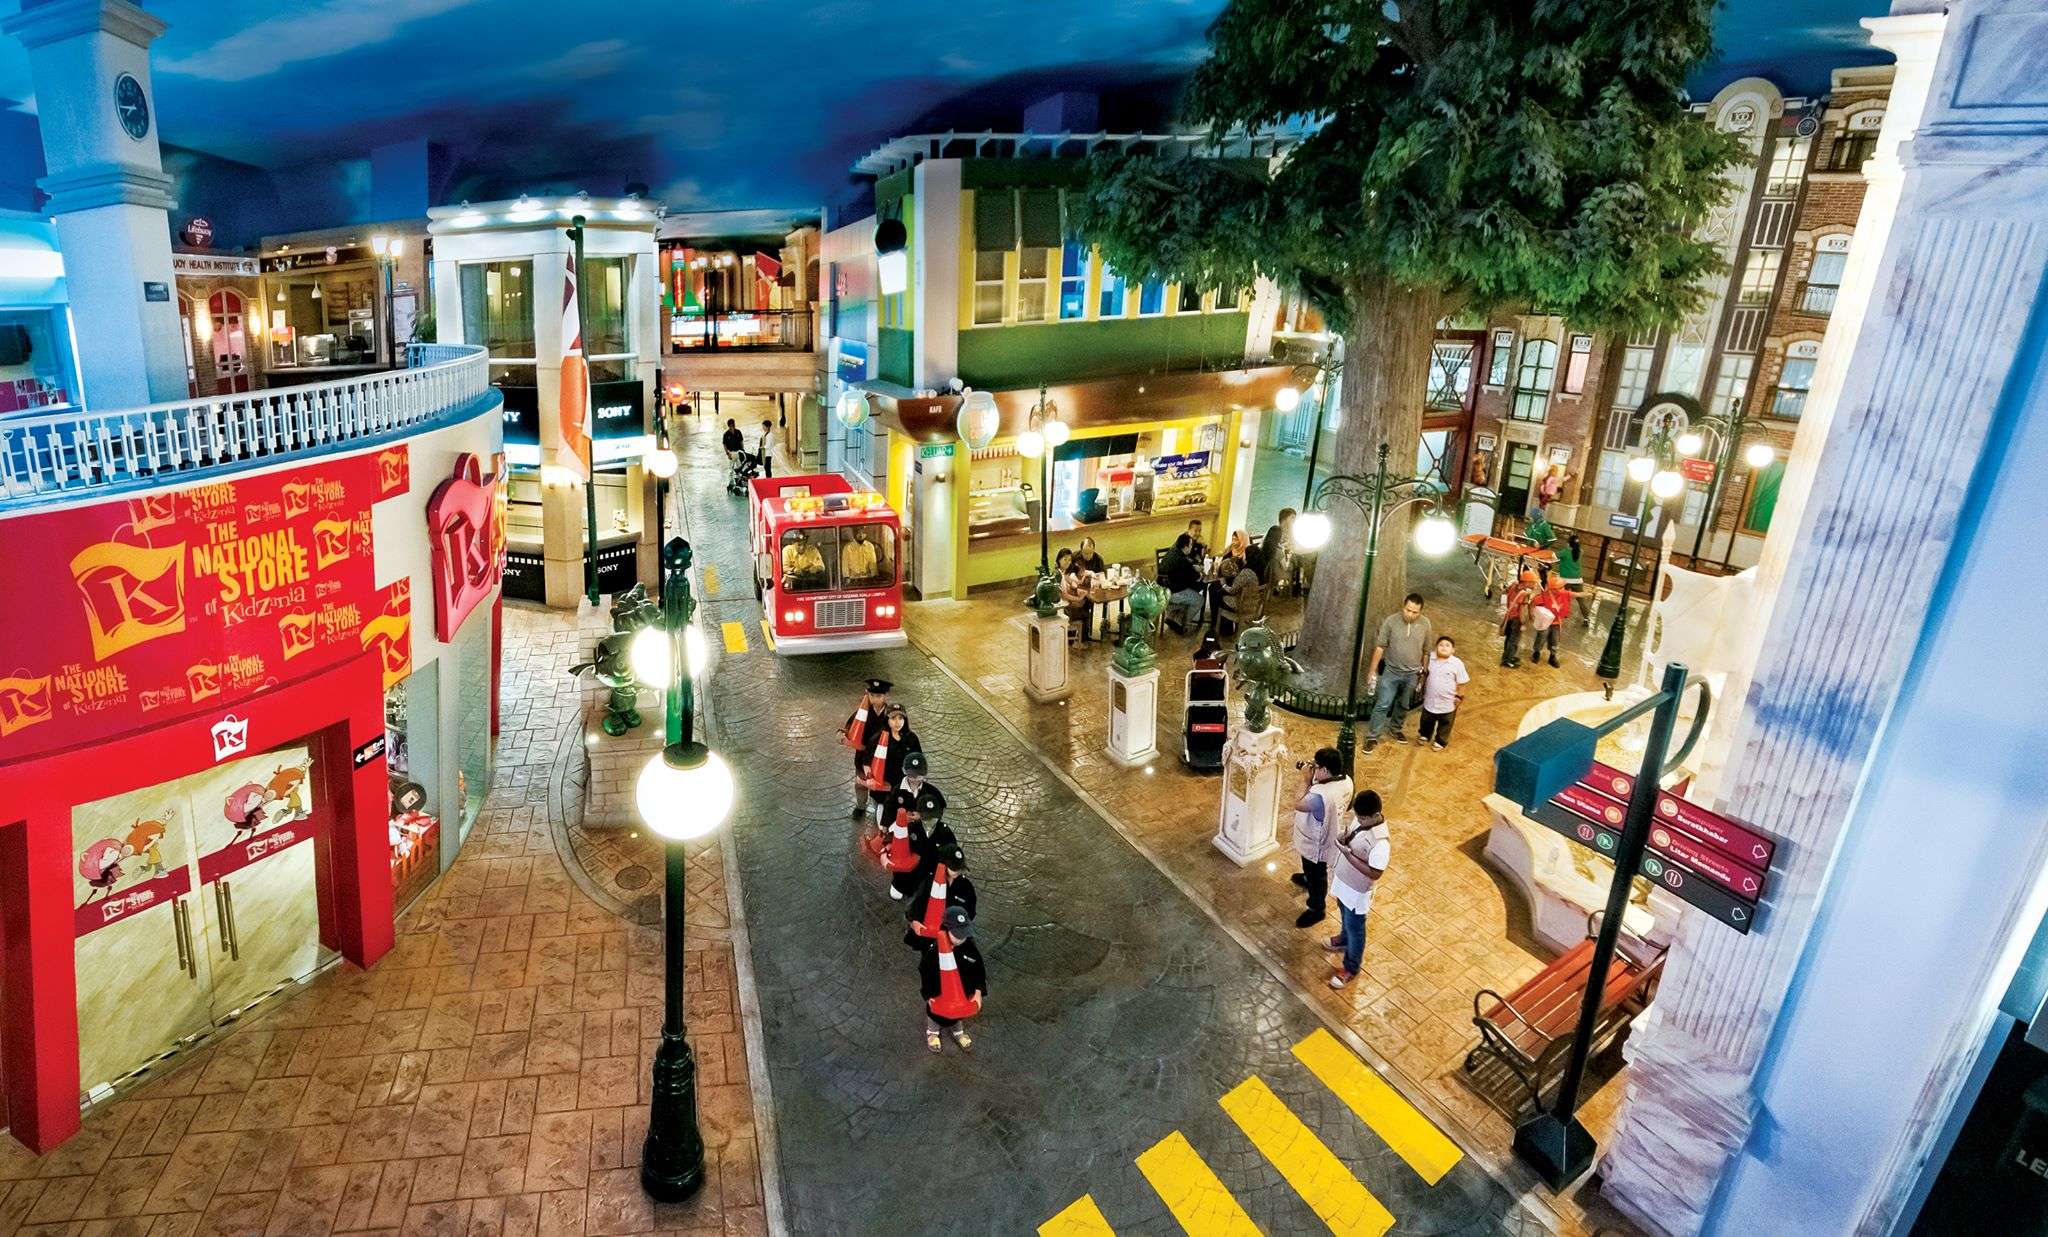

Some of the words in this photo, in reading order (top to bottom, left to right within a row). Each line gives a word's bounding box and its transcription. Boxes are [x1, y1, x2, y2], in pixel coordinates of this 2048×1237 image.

[189, 260, 211, 270] HEALTH
[597, 405, 631, 419] SONY
[191, 482, 238, 512] STORE
[318, 485, 346, 504] STORE
[206, 521, 239, 545] THE
[192, 527, 303, 578] NATIONAL
[218, 547, 311, 602] STORE
[597, 563, 620, 575] SONY
[205, 598, 217, 616] of
[220, 585, 307, 629] KidZania
[316, 602, 359, 626] NATIONAL
[325, 611, 362, 635] STORE
[54, 664, 120, 692] NATIONAL
[62, 663, 82, 676] THE
[232, 660, 265, 682] STORE
[70, 673, 129, 704] STORE
